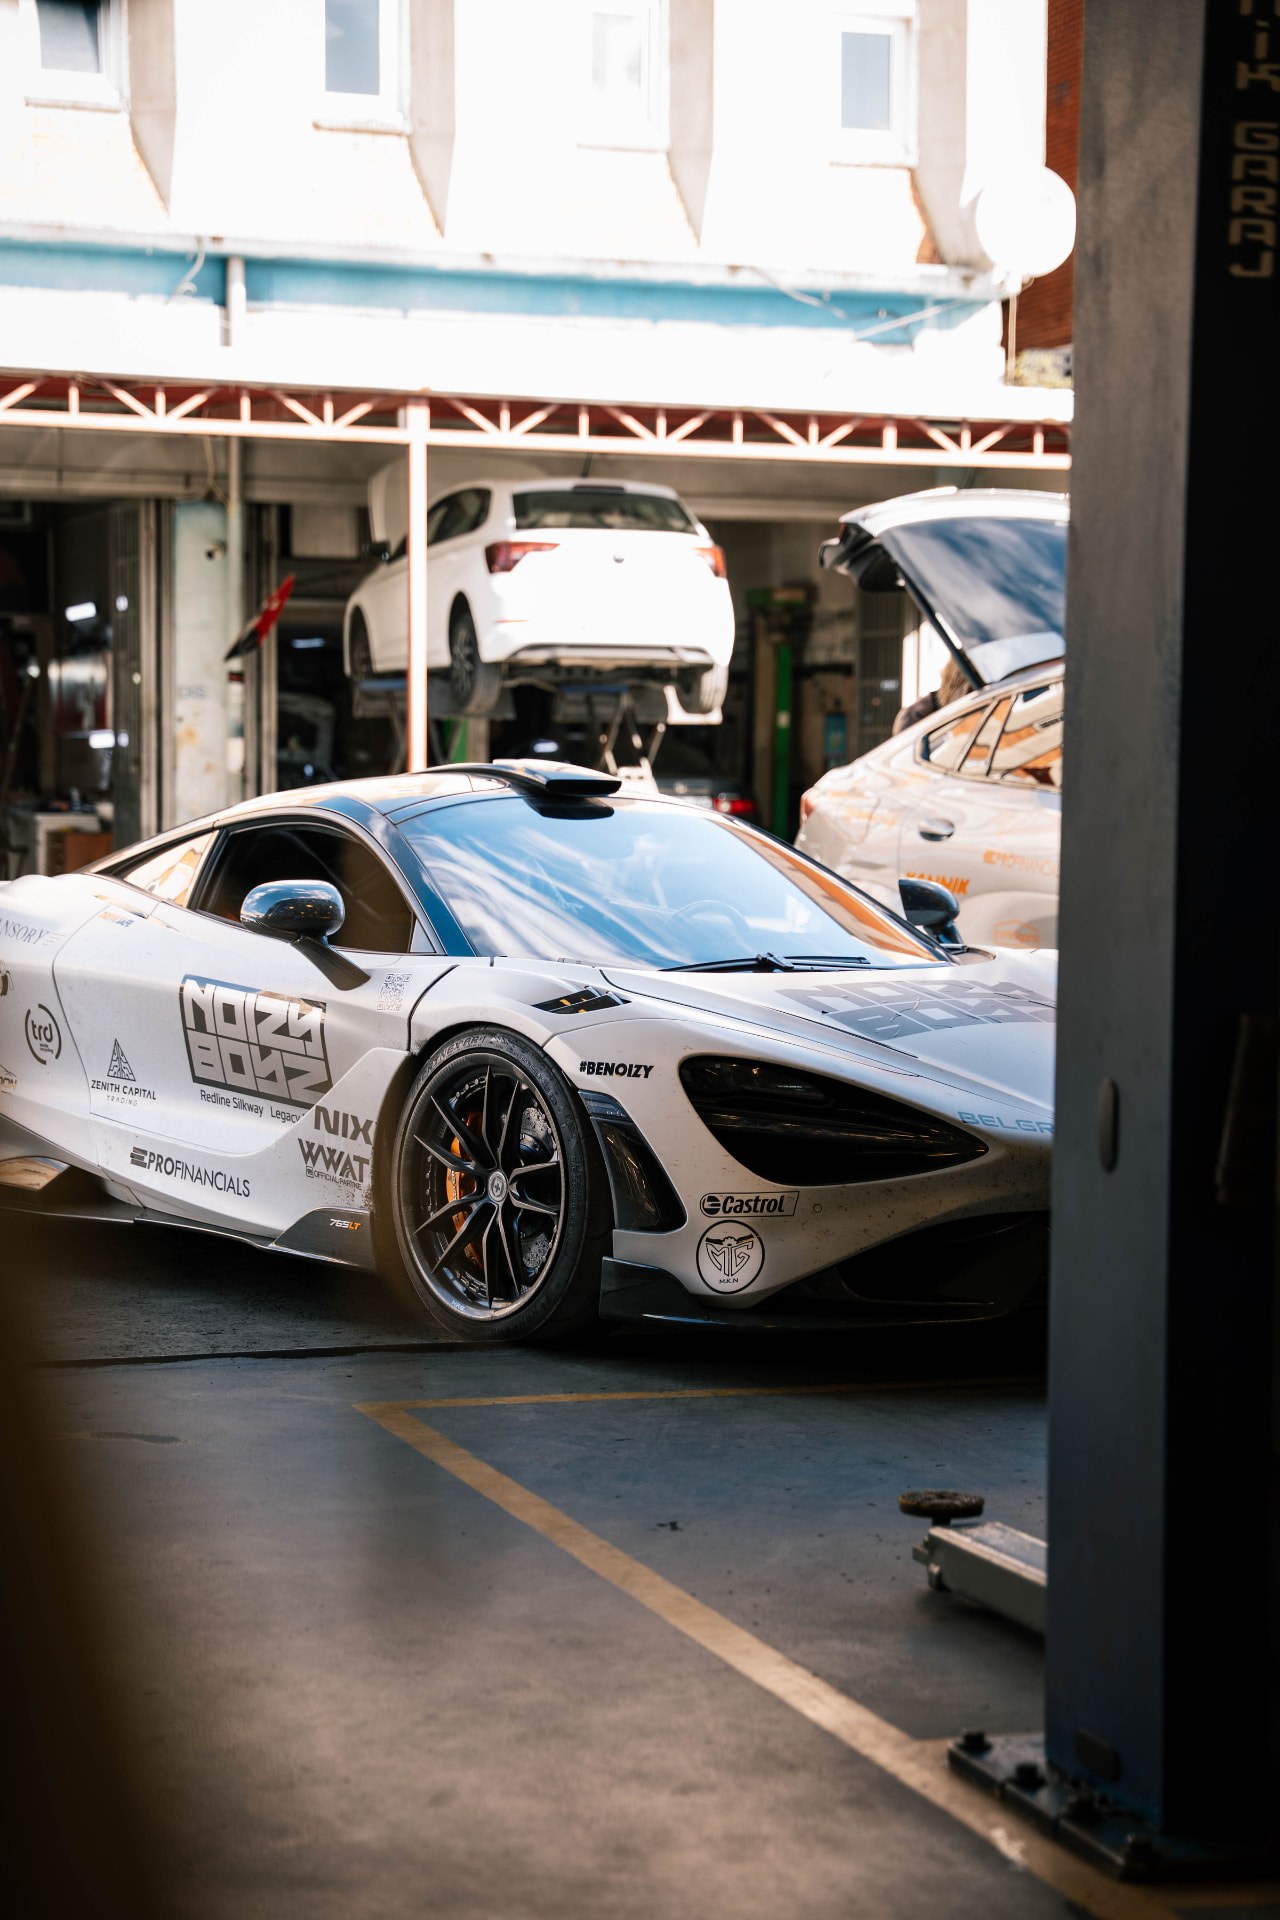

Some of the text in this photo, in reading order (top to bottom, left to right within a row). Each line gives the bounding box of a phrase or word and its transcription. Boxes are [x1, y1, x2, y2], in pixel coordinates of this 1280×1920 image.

[0, 918, 50, 945] NSORY
[31, 1019, 54, 1043] trd
[579, 1061, 654, 1079] #BENOIZY
[91, 1079, 157, 1101] ZENITH CAPITAL
[106, 1095, 138, 1107] TRADING
[200, 1089, 231, 1107] Redline
[232, 1097, 264, 1118] Silkway
[722, 1195, 785, 1214] Castrol
[329, 1218, 362, 1231] 765LT
